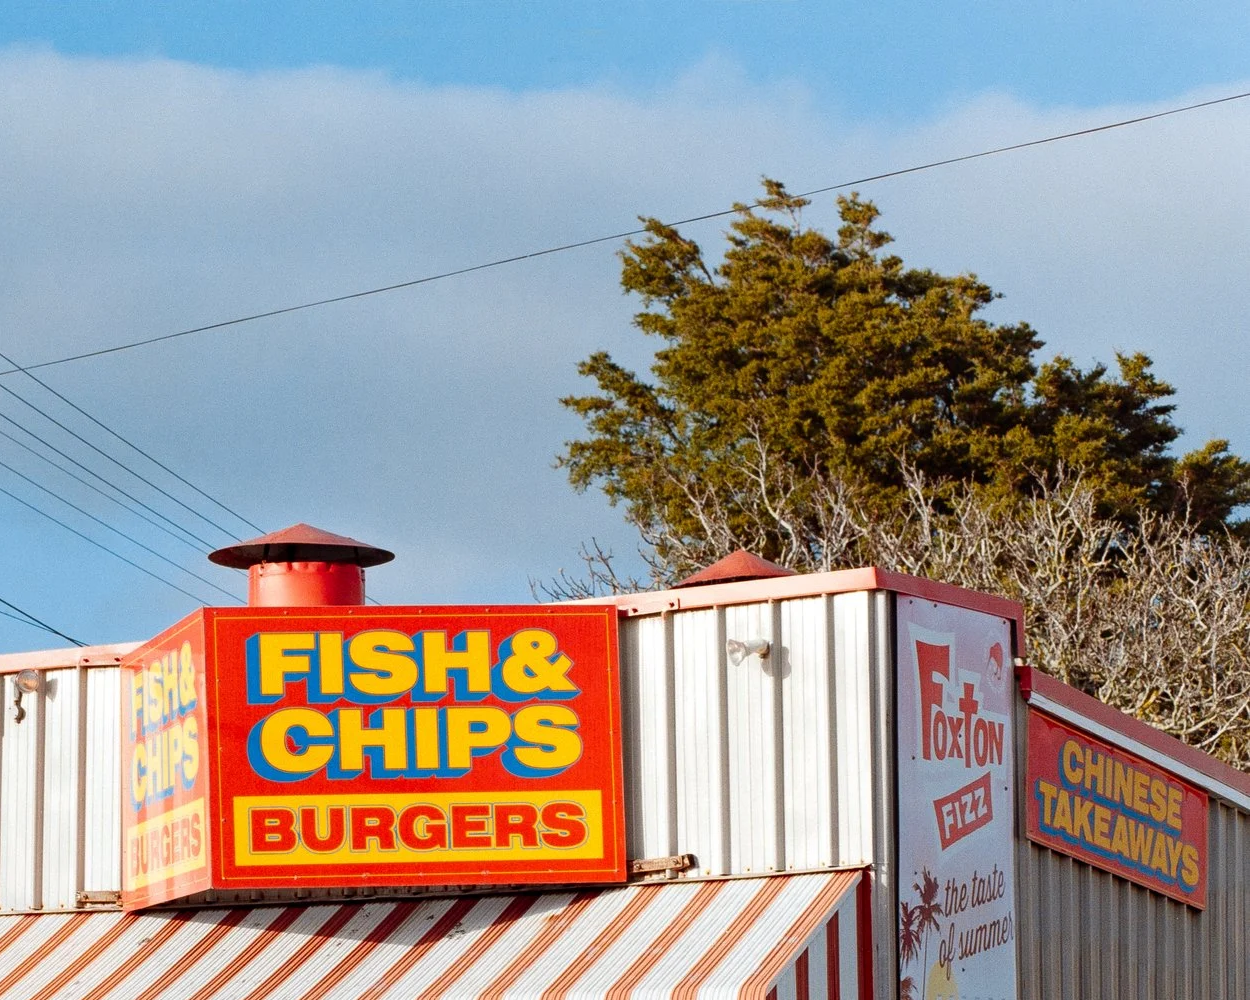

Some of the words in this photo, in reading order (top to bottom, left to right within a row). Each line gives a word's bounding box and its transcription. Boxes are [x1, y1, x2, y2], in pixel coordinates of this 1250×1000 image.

[130, 647, 177, 740] FISH
[248, 629, 491, 703] FISH
[496, 628, 580, 702] &
[131, 715, 200, 812] CHIPS
[248, 703, 582, 781] CHIPS
[941, 786, 989, 840] FIZZ
[1060, 739, 1183, 833] CHINESE
[131, 812, 201, 878] BURGERS
[249, 801, 588, 855] BURGERS
[1037, 778, 1199, 891] TAKEAWAYS
[944, 877, 967, 918] the
[971, 863, 1006, 908] taste
[939, 922, 956, 981] of
[958, 910, 1014, 961] summer
